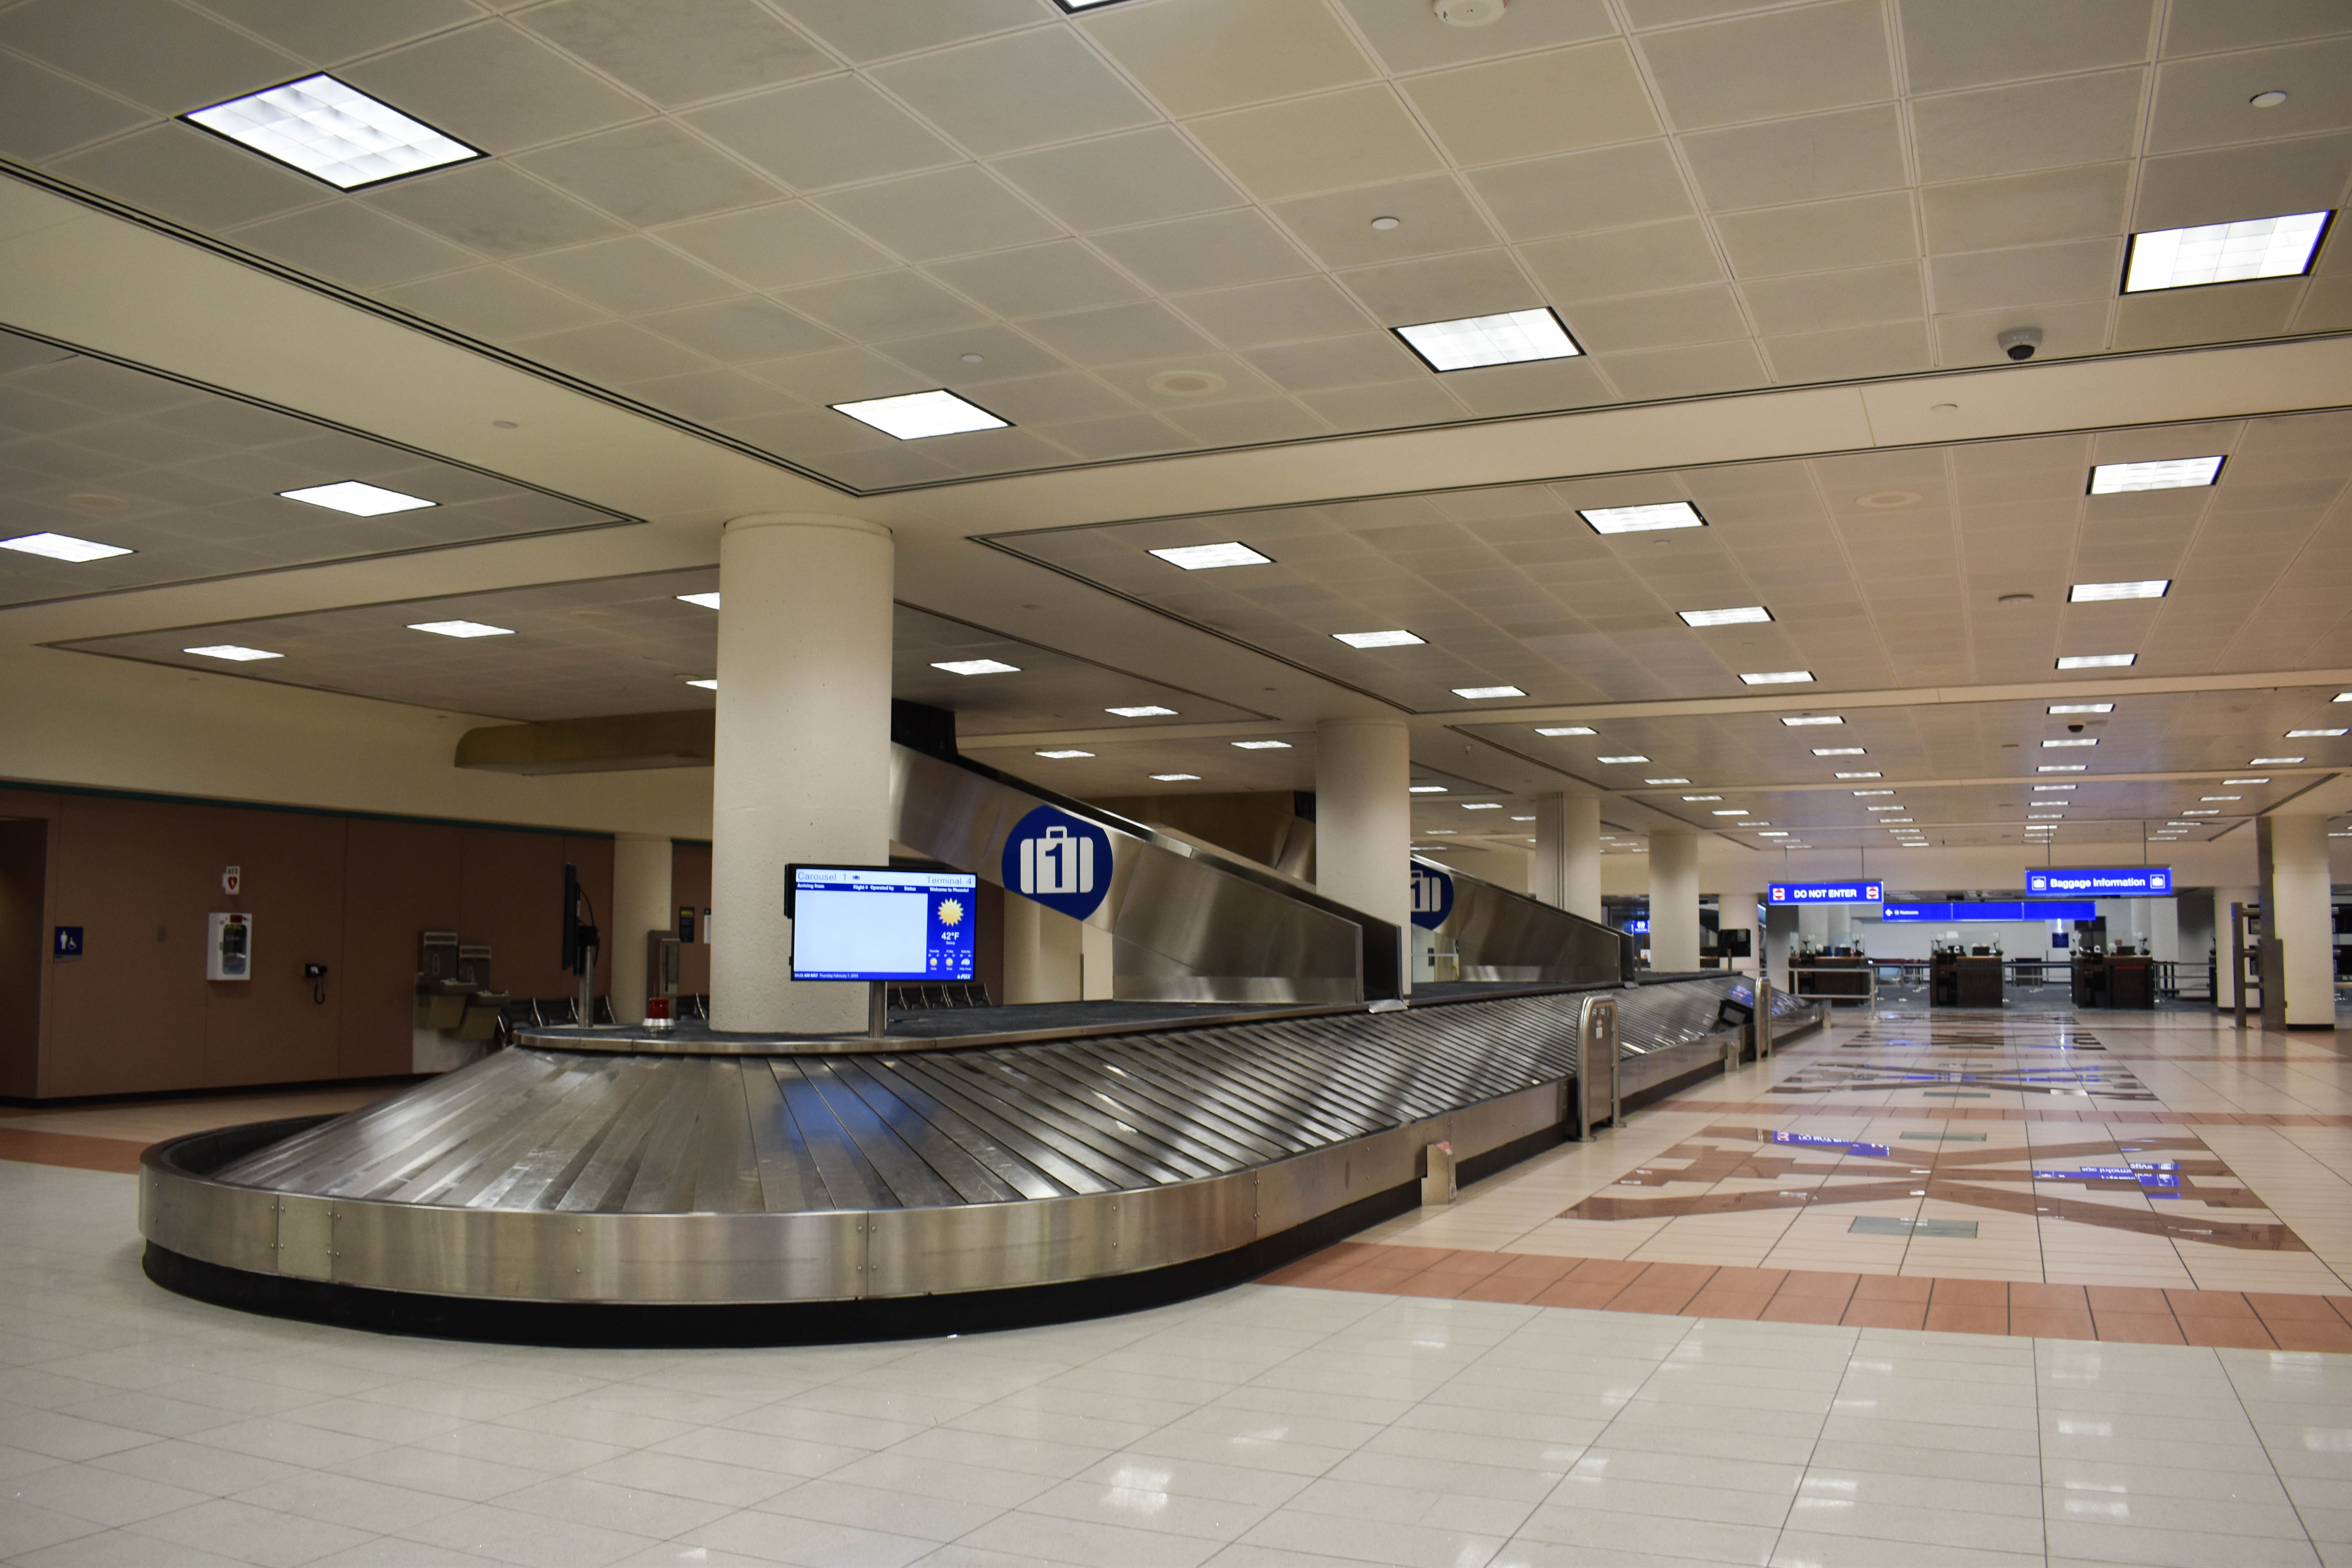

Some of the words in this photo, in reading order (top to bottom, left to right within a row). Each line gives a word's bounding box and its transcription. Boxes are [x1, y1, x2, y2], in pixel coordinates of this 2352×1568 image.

[1045, 843, 1063, 888] 1
[798, 872, 836, 881] Carousel
[927, 876, 962, 885] Terminal
[2050, 878, 2091, 889] Baggage
[2093, 878, 2145, 887] Information
[1794, 889, 1807, 898] DO
[1809, 889, 1827, 898] NOT
[1828, 889, 1857, 898] ENTER
[941, 931, 959, 940] 42°F
